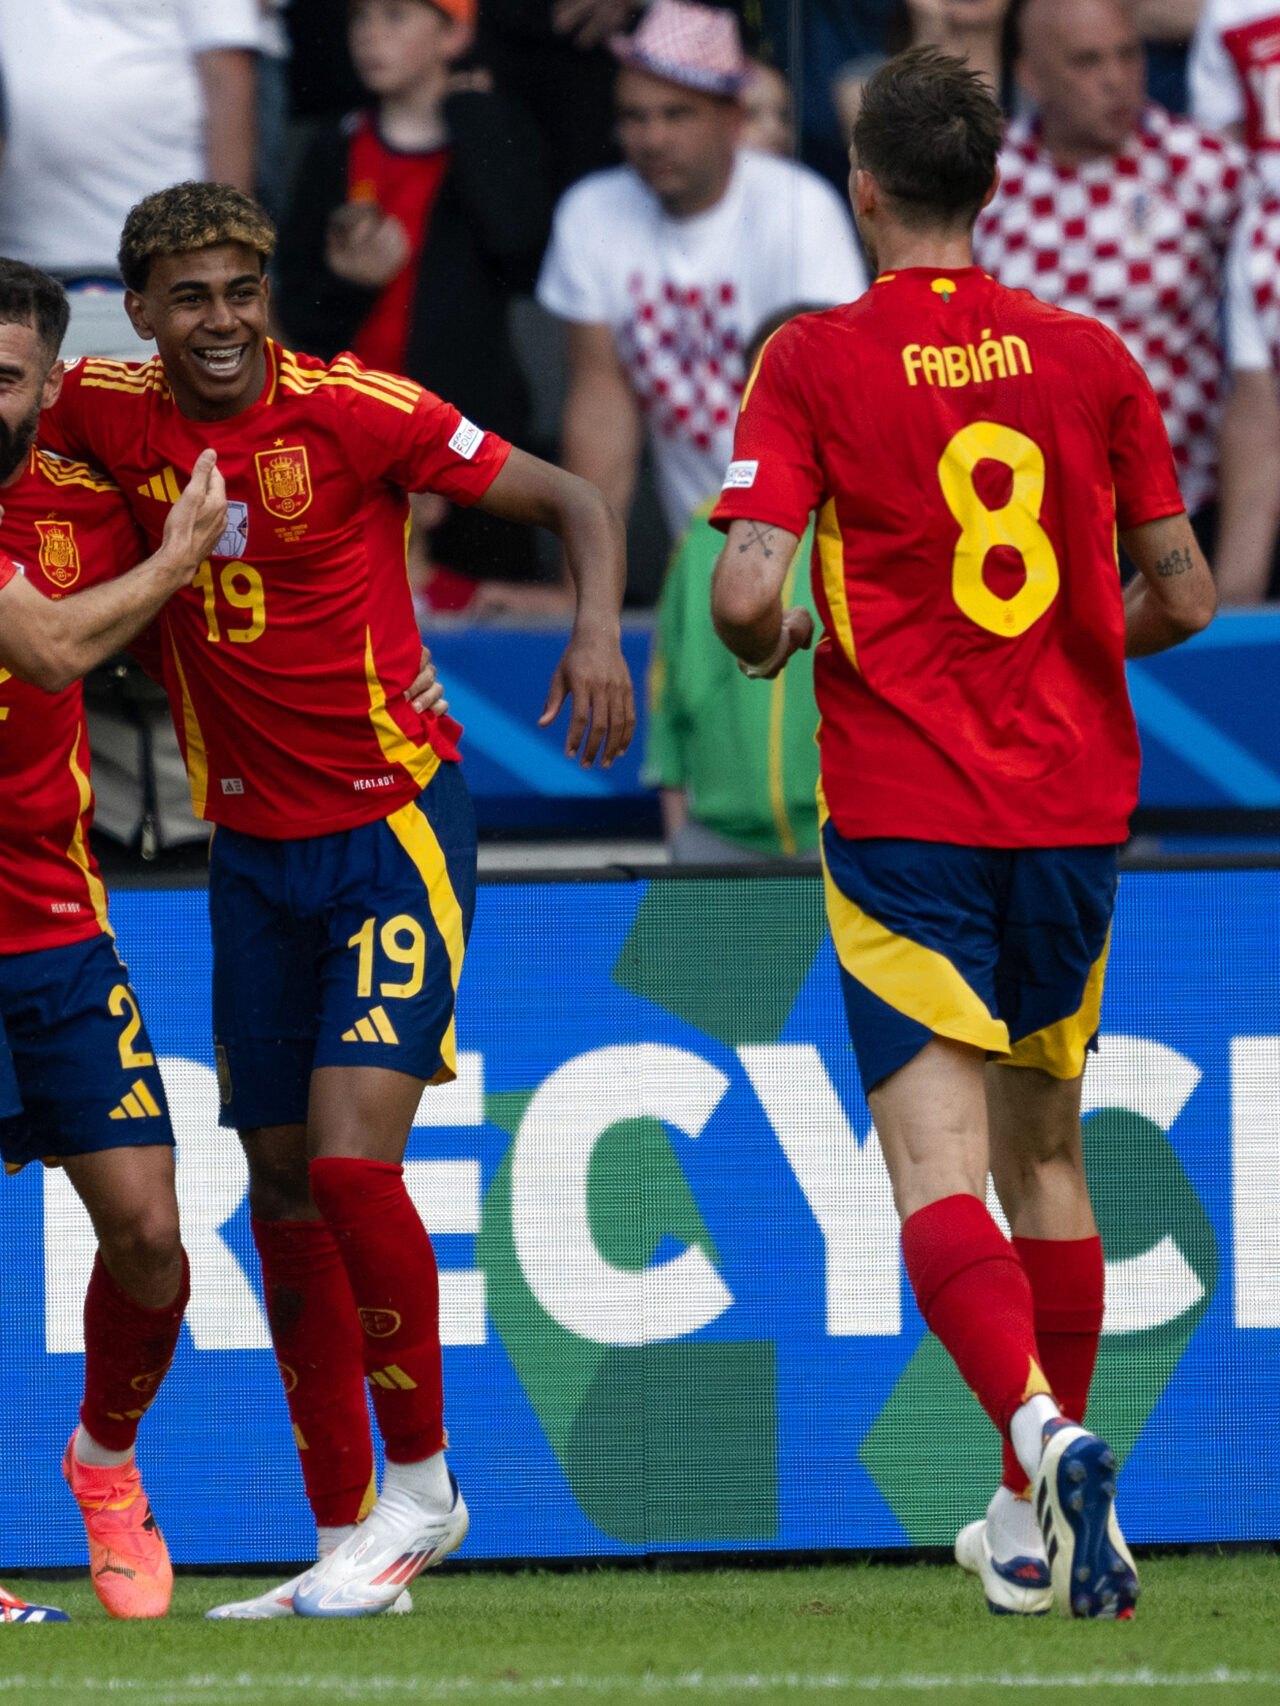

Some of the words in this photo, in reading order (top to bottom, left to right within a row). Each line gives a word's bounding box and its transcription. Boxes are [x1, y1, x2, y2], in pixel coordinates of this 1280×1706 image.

[902, 328, 1033, 388] FABIÁN
[937, 421, 1060, 638] 8
[191, 559, 266, 643] 19
[353, 774, 395, 791] HEAT.RDY
[347, 914, 426, 999] 19
[107, 984, 154, 1069] 2
